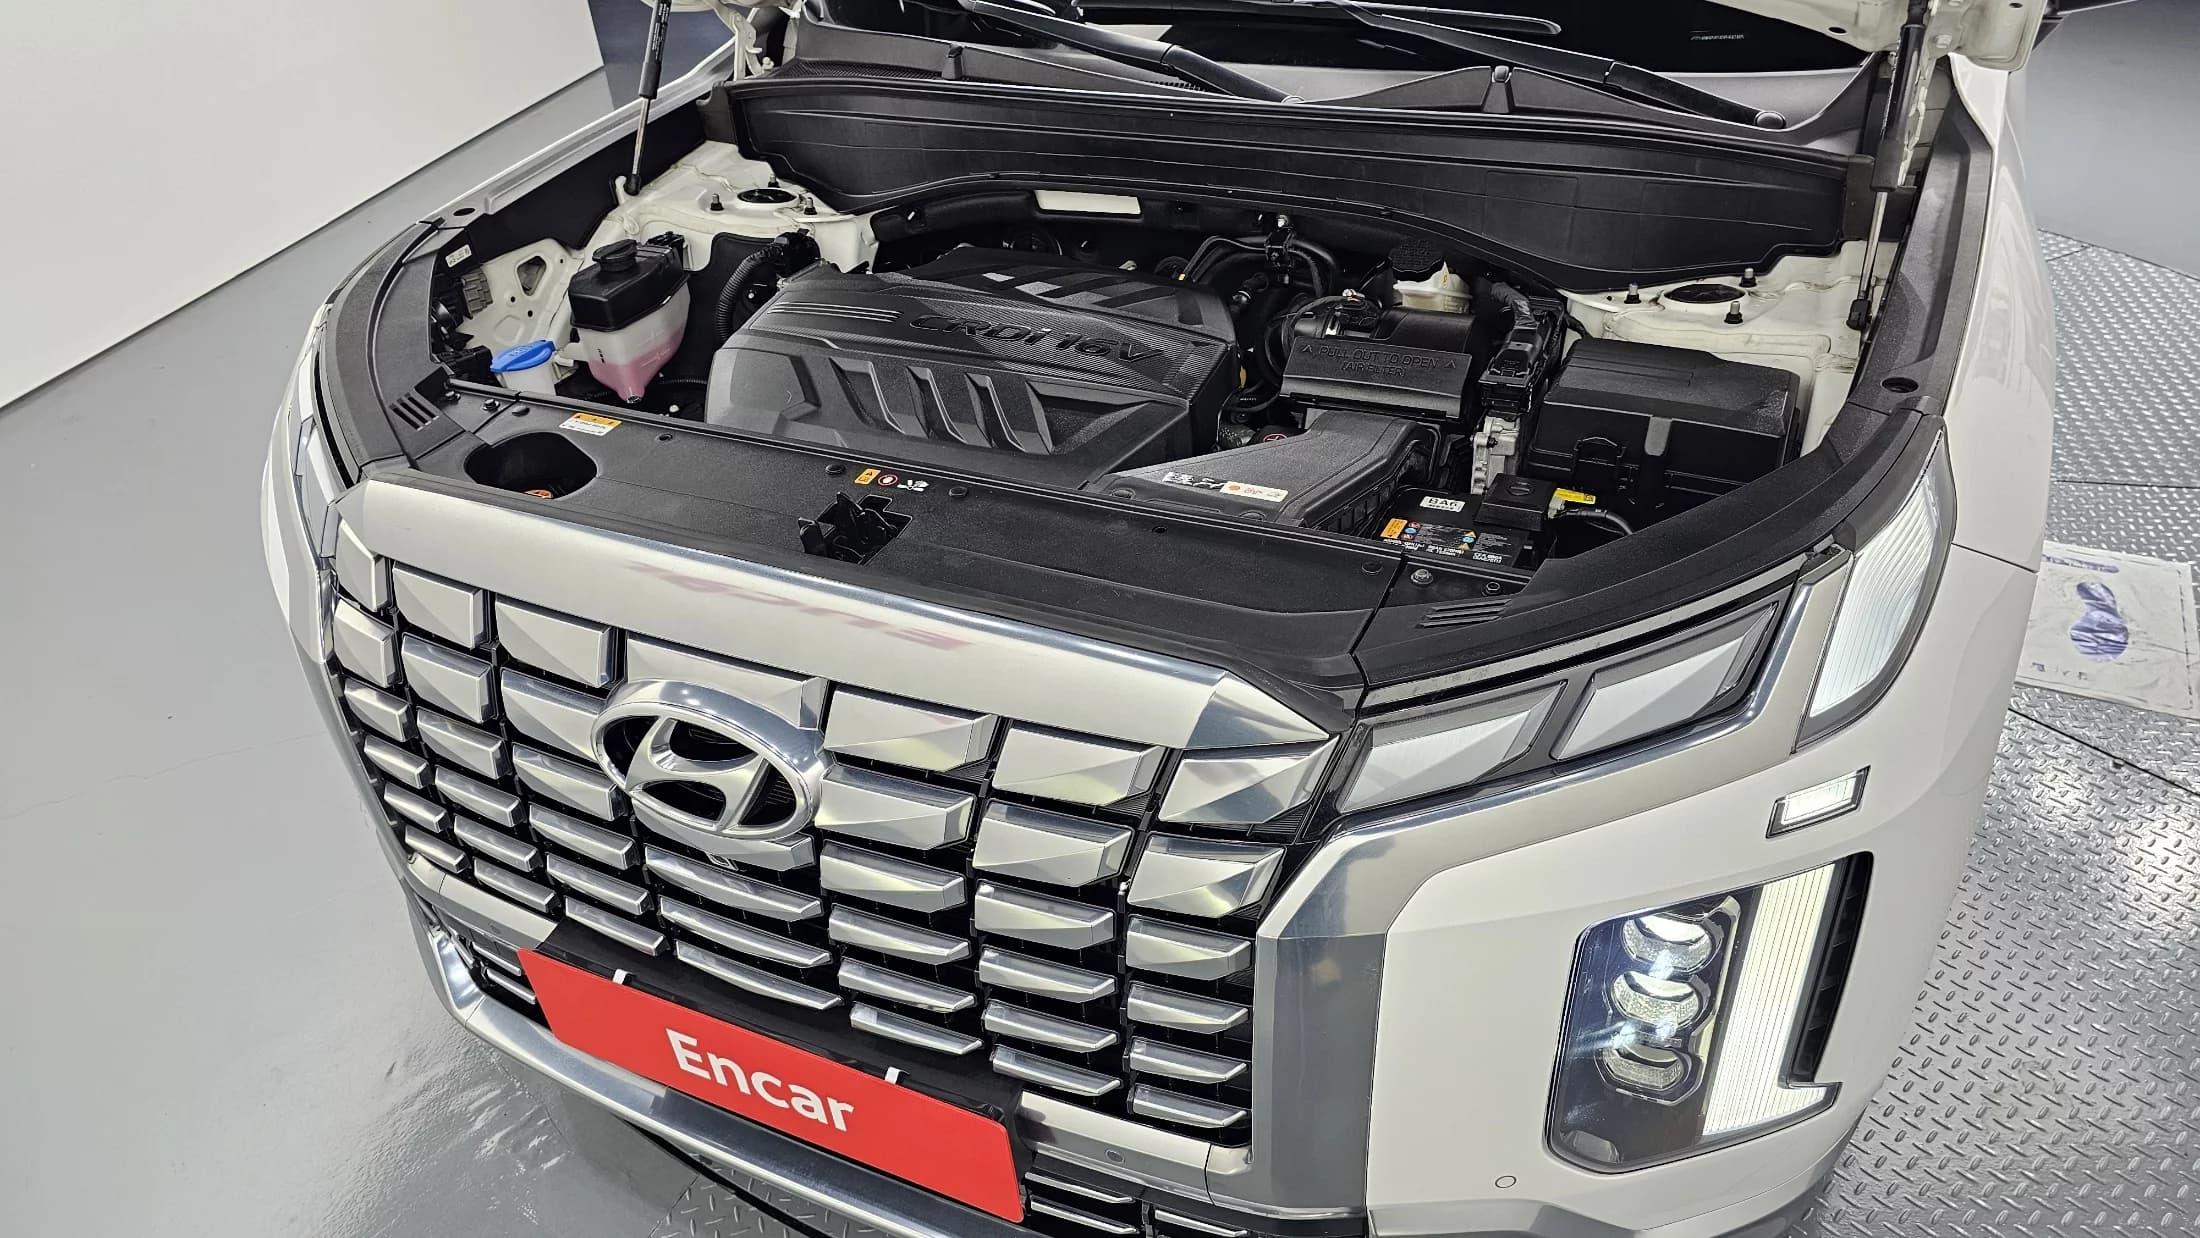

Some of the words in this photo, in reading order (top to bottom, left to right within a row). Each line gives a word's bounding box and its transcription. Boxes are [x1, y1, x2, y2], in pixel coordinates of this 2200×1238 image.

[909, 314, 1052, 346] CRDi
[1055, 331, 1165, 363] 16V
[1318, 345, 1349, 359] PULL
[1353, 347, 1380, 361] OUT
[1383, 351, 1400, 364] TO
[1402, 354, 1440, 369] OPEN
[1341, 360, 1366, 371] (AIR
[665, 1027, 855, 1132] Encar
